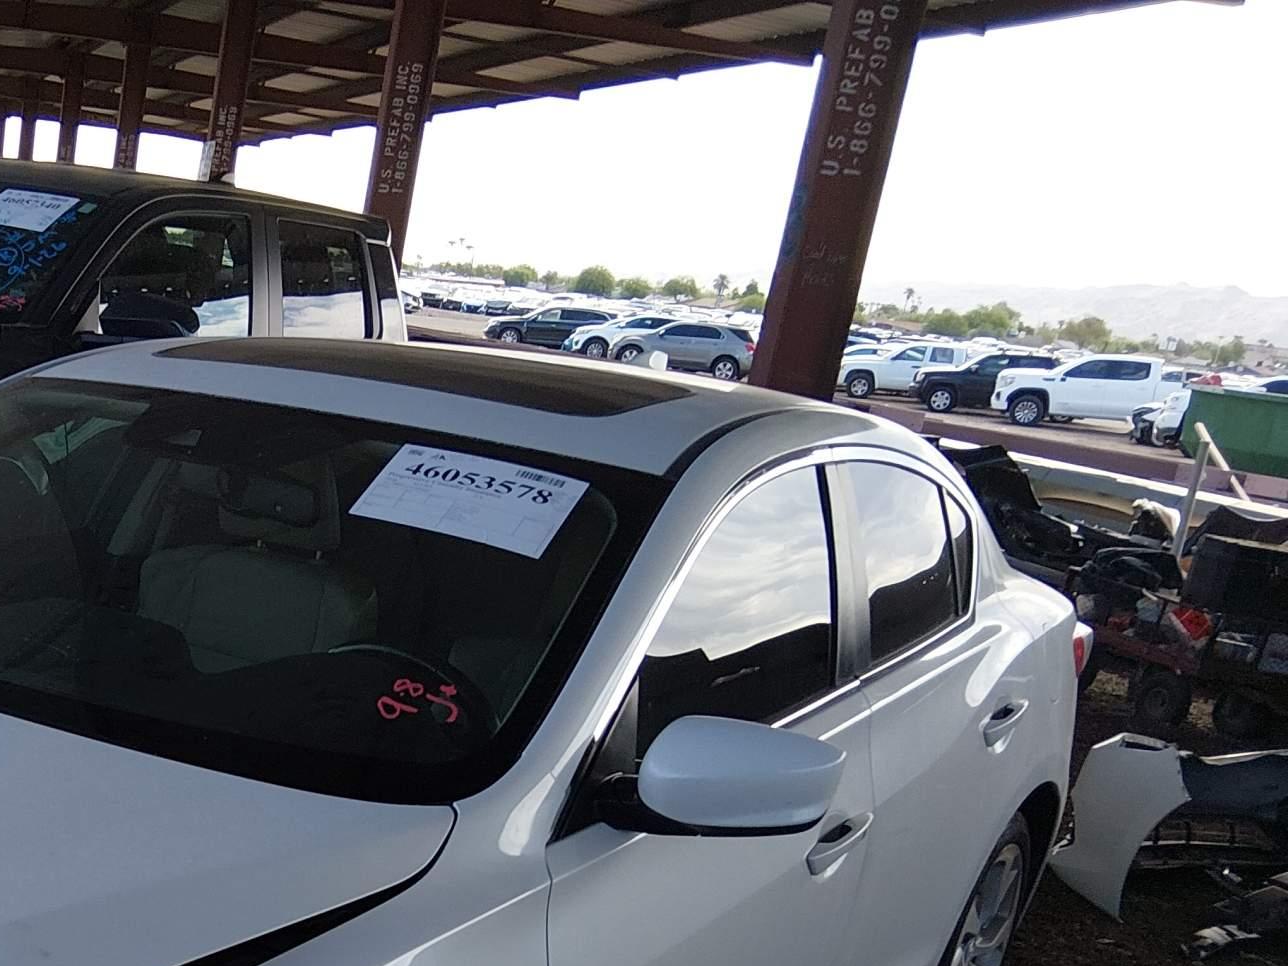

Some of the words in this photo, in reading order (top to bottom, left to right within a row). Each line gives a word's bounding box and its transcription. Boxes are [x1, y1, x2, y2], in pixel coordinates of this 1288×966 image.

[384, 97, 404, 156] PREFAB
[395, 61, 410, 90] INC.
[836, 9, 874, 112] PREFAB
[843, 0, 902, 175] 1-866-799-0
[404, 462, 553, 505] 46053578
